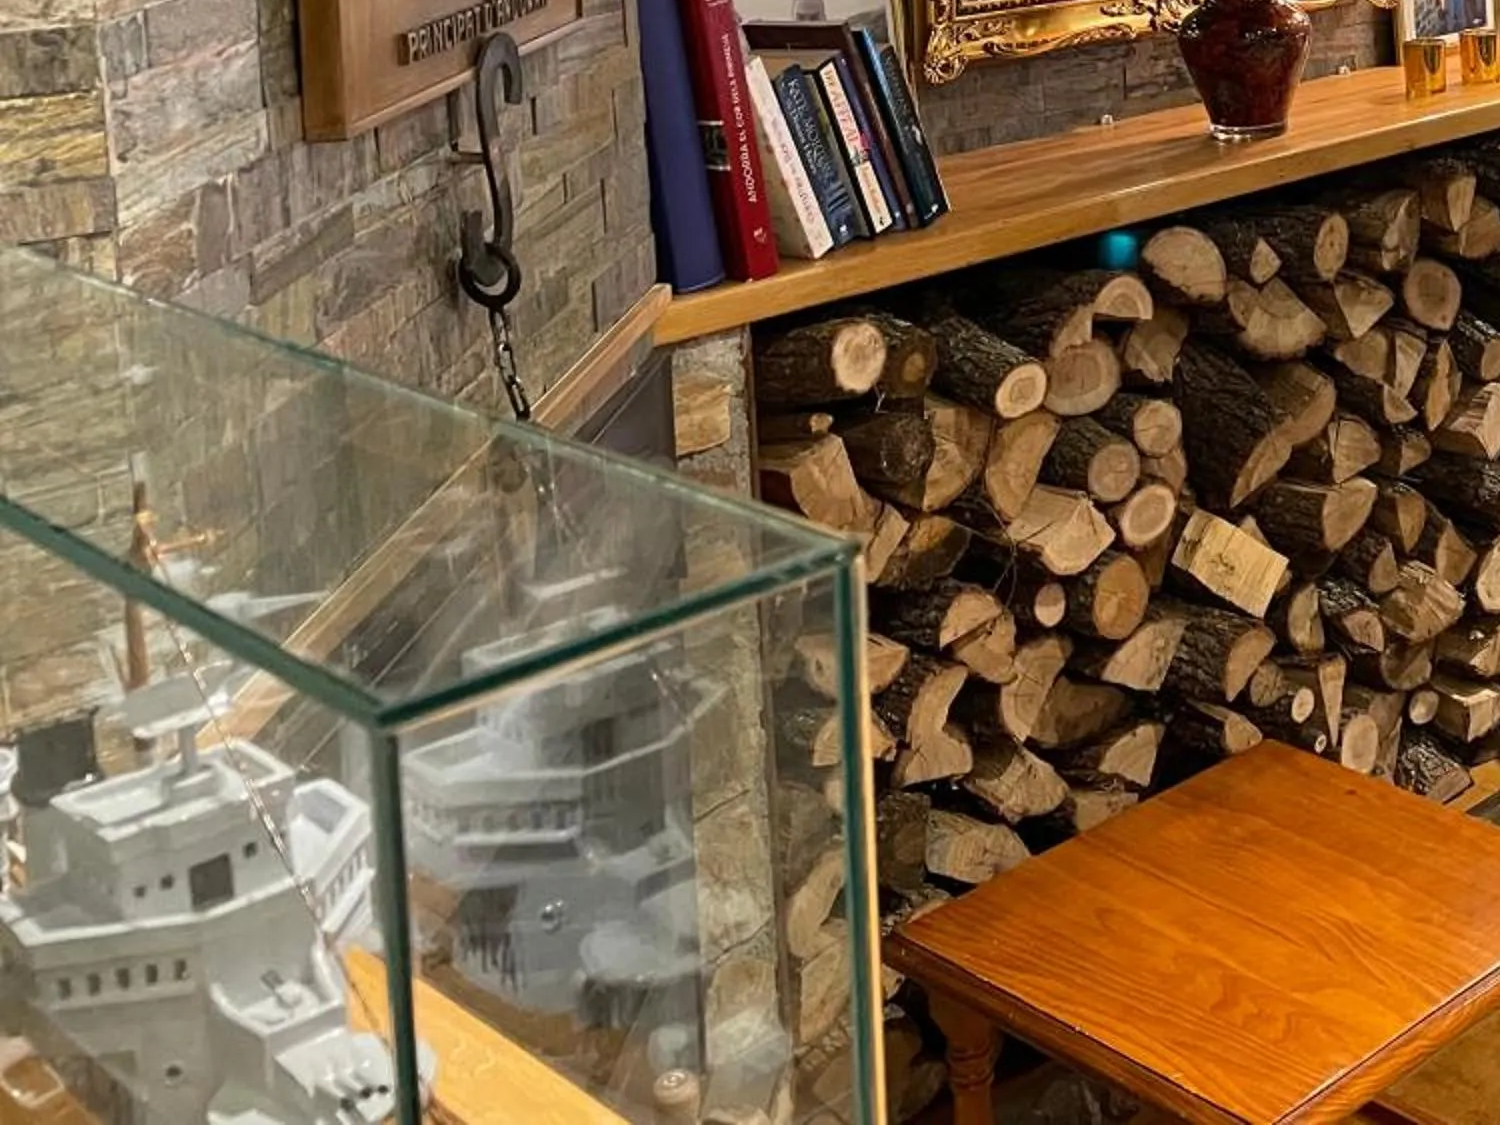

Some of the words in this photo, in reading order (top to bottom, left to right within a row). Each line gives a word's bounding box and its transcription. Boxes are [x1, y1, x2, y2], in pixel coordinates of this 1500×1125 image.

[407, 4, 483, 63] PRINCIPAT
[786, 78, 807, 113] KATE
[740, 144, 757, 202] ANDORRA
